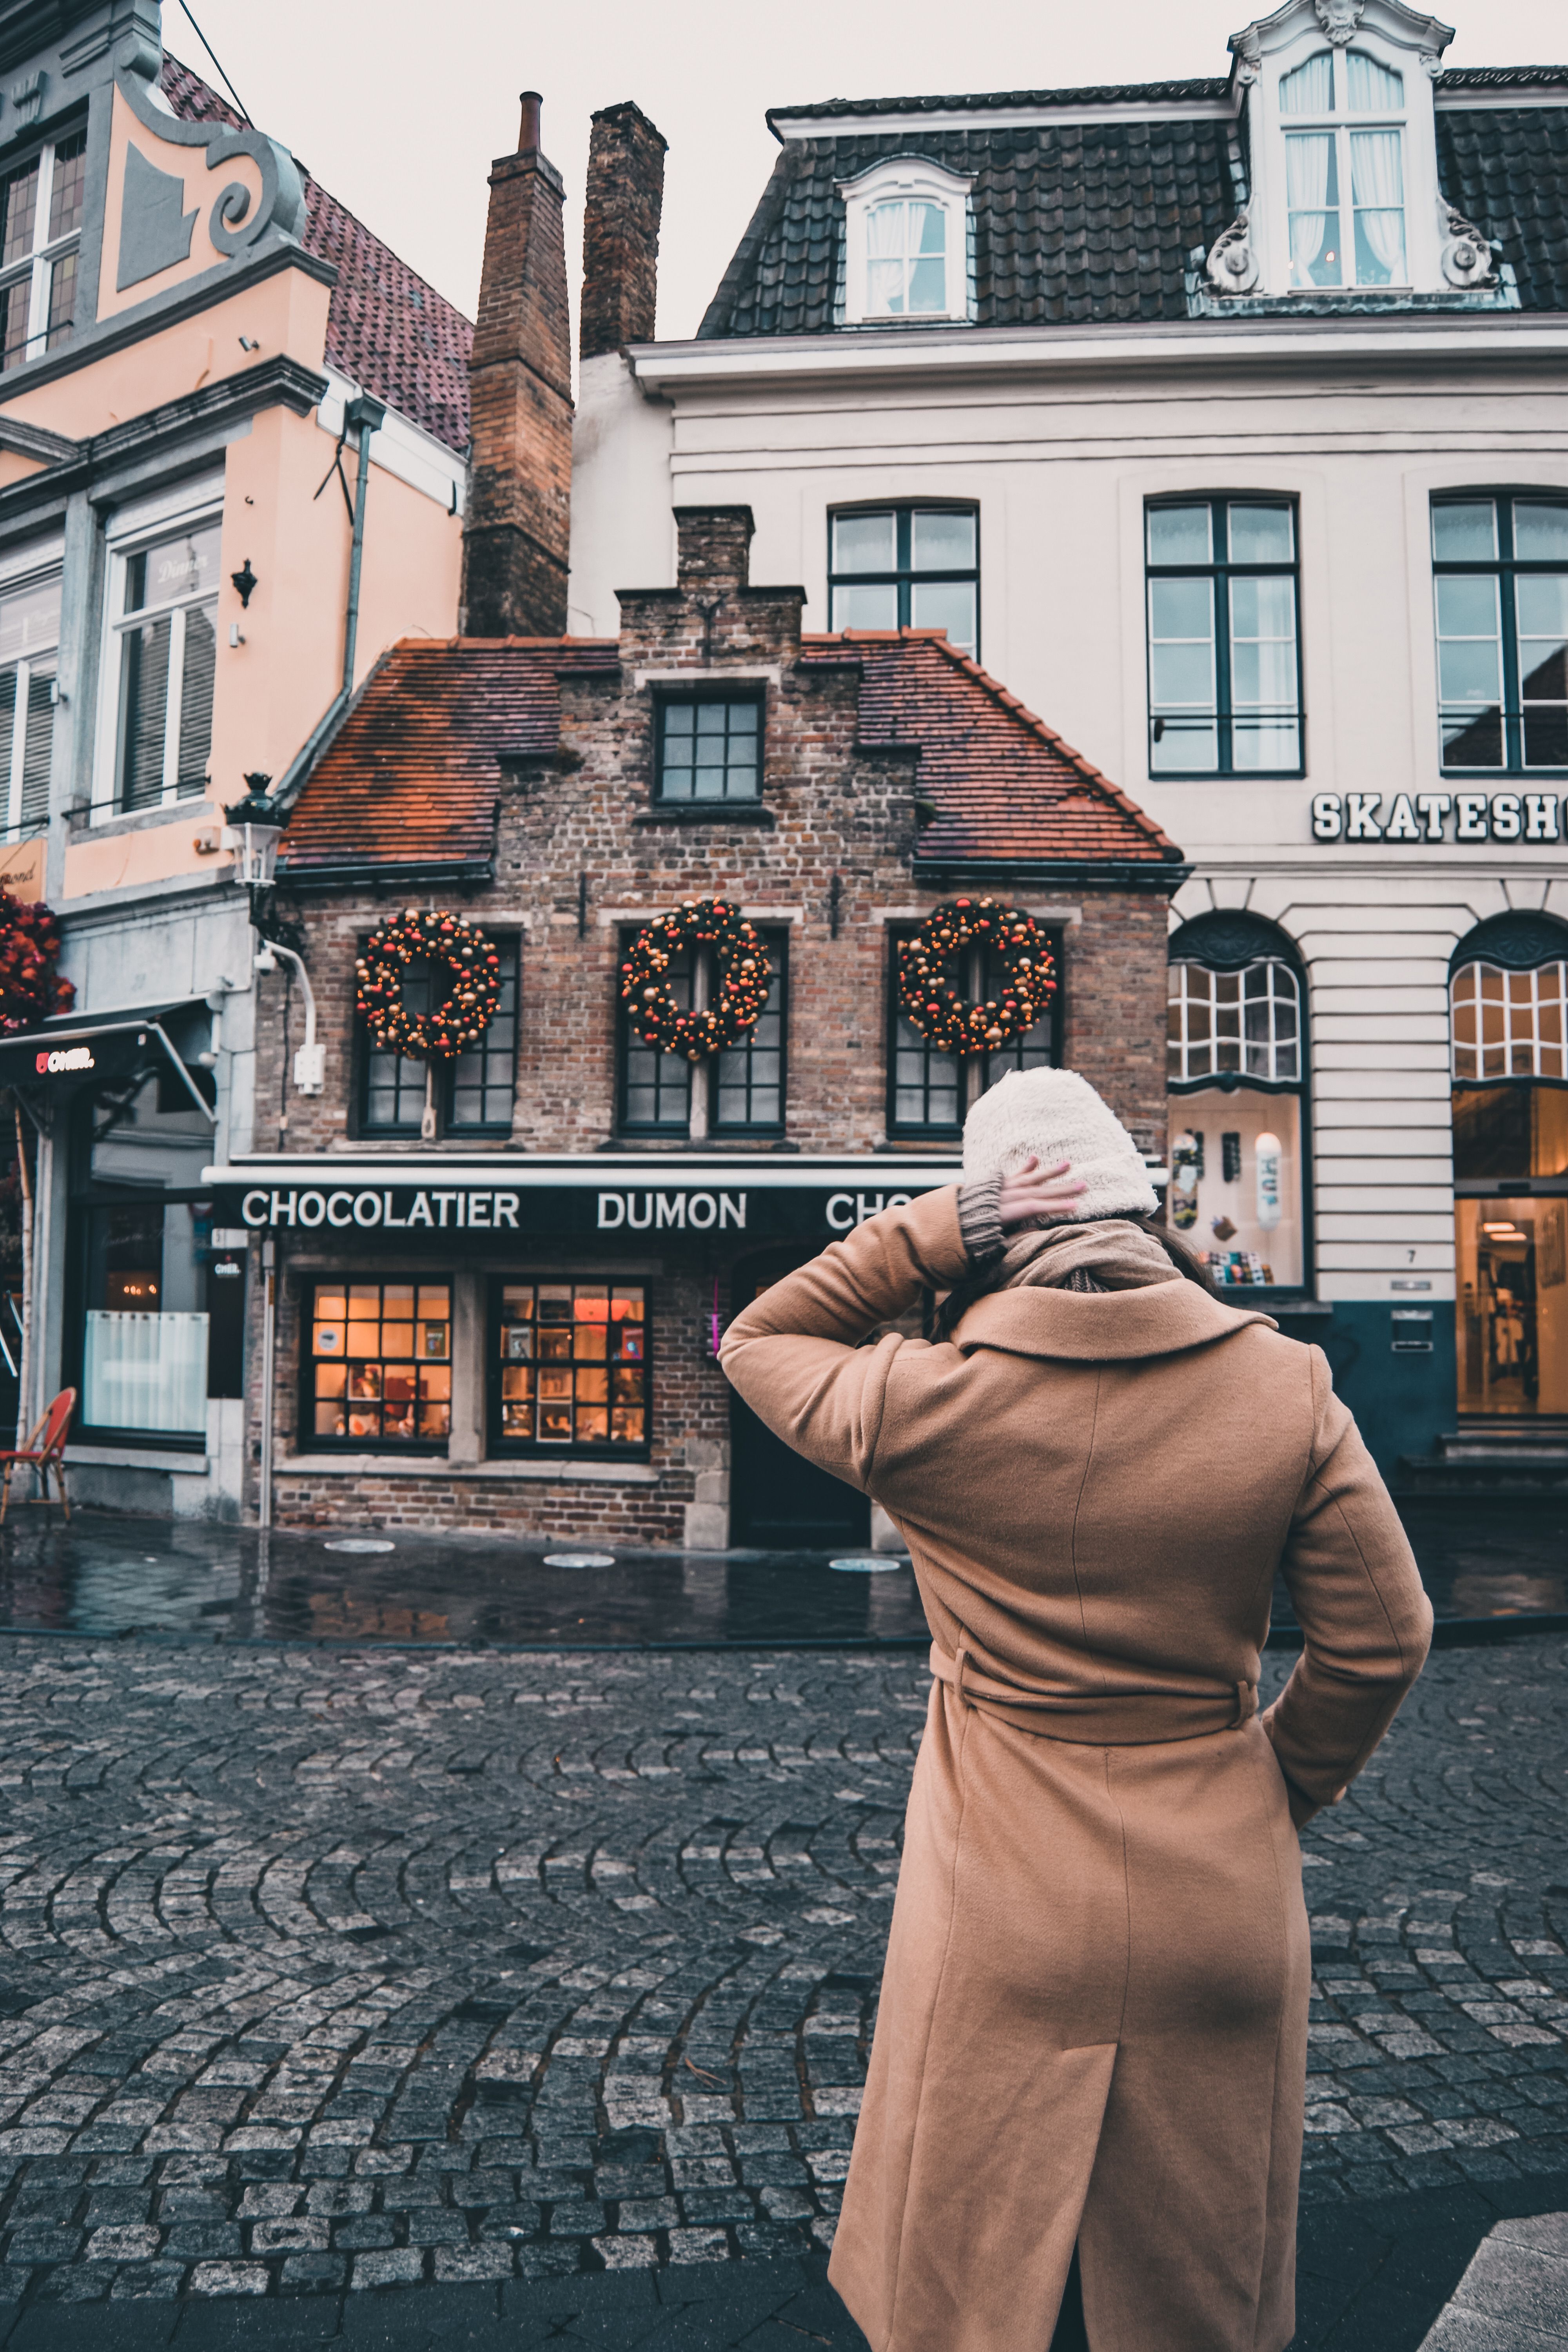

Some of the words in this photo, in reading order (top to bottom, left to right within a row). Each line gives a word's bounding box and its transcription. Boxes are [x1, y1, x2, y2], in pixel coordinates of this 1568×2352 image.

[1312, 793, 1568, 842] SKATESH
[242, 1190, 519, 1227] CHOCOLATIER
[597, 1192, 746, 1229] DUMON
[1407, 1249, 1416, 1263] 7
